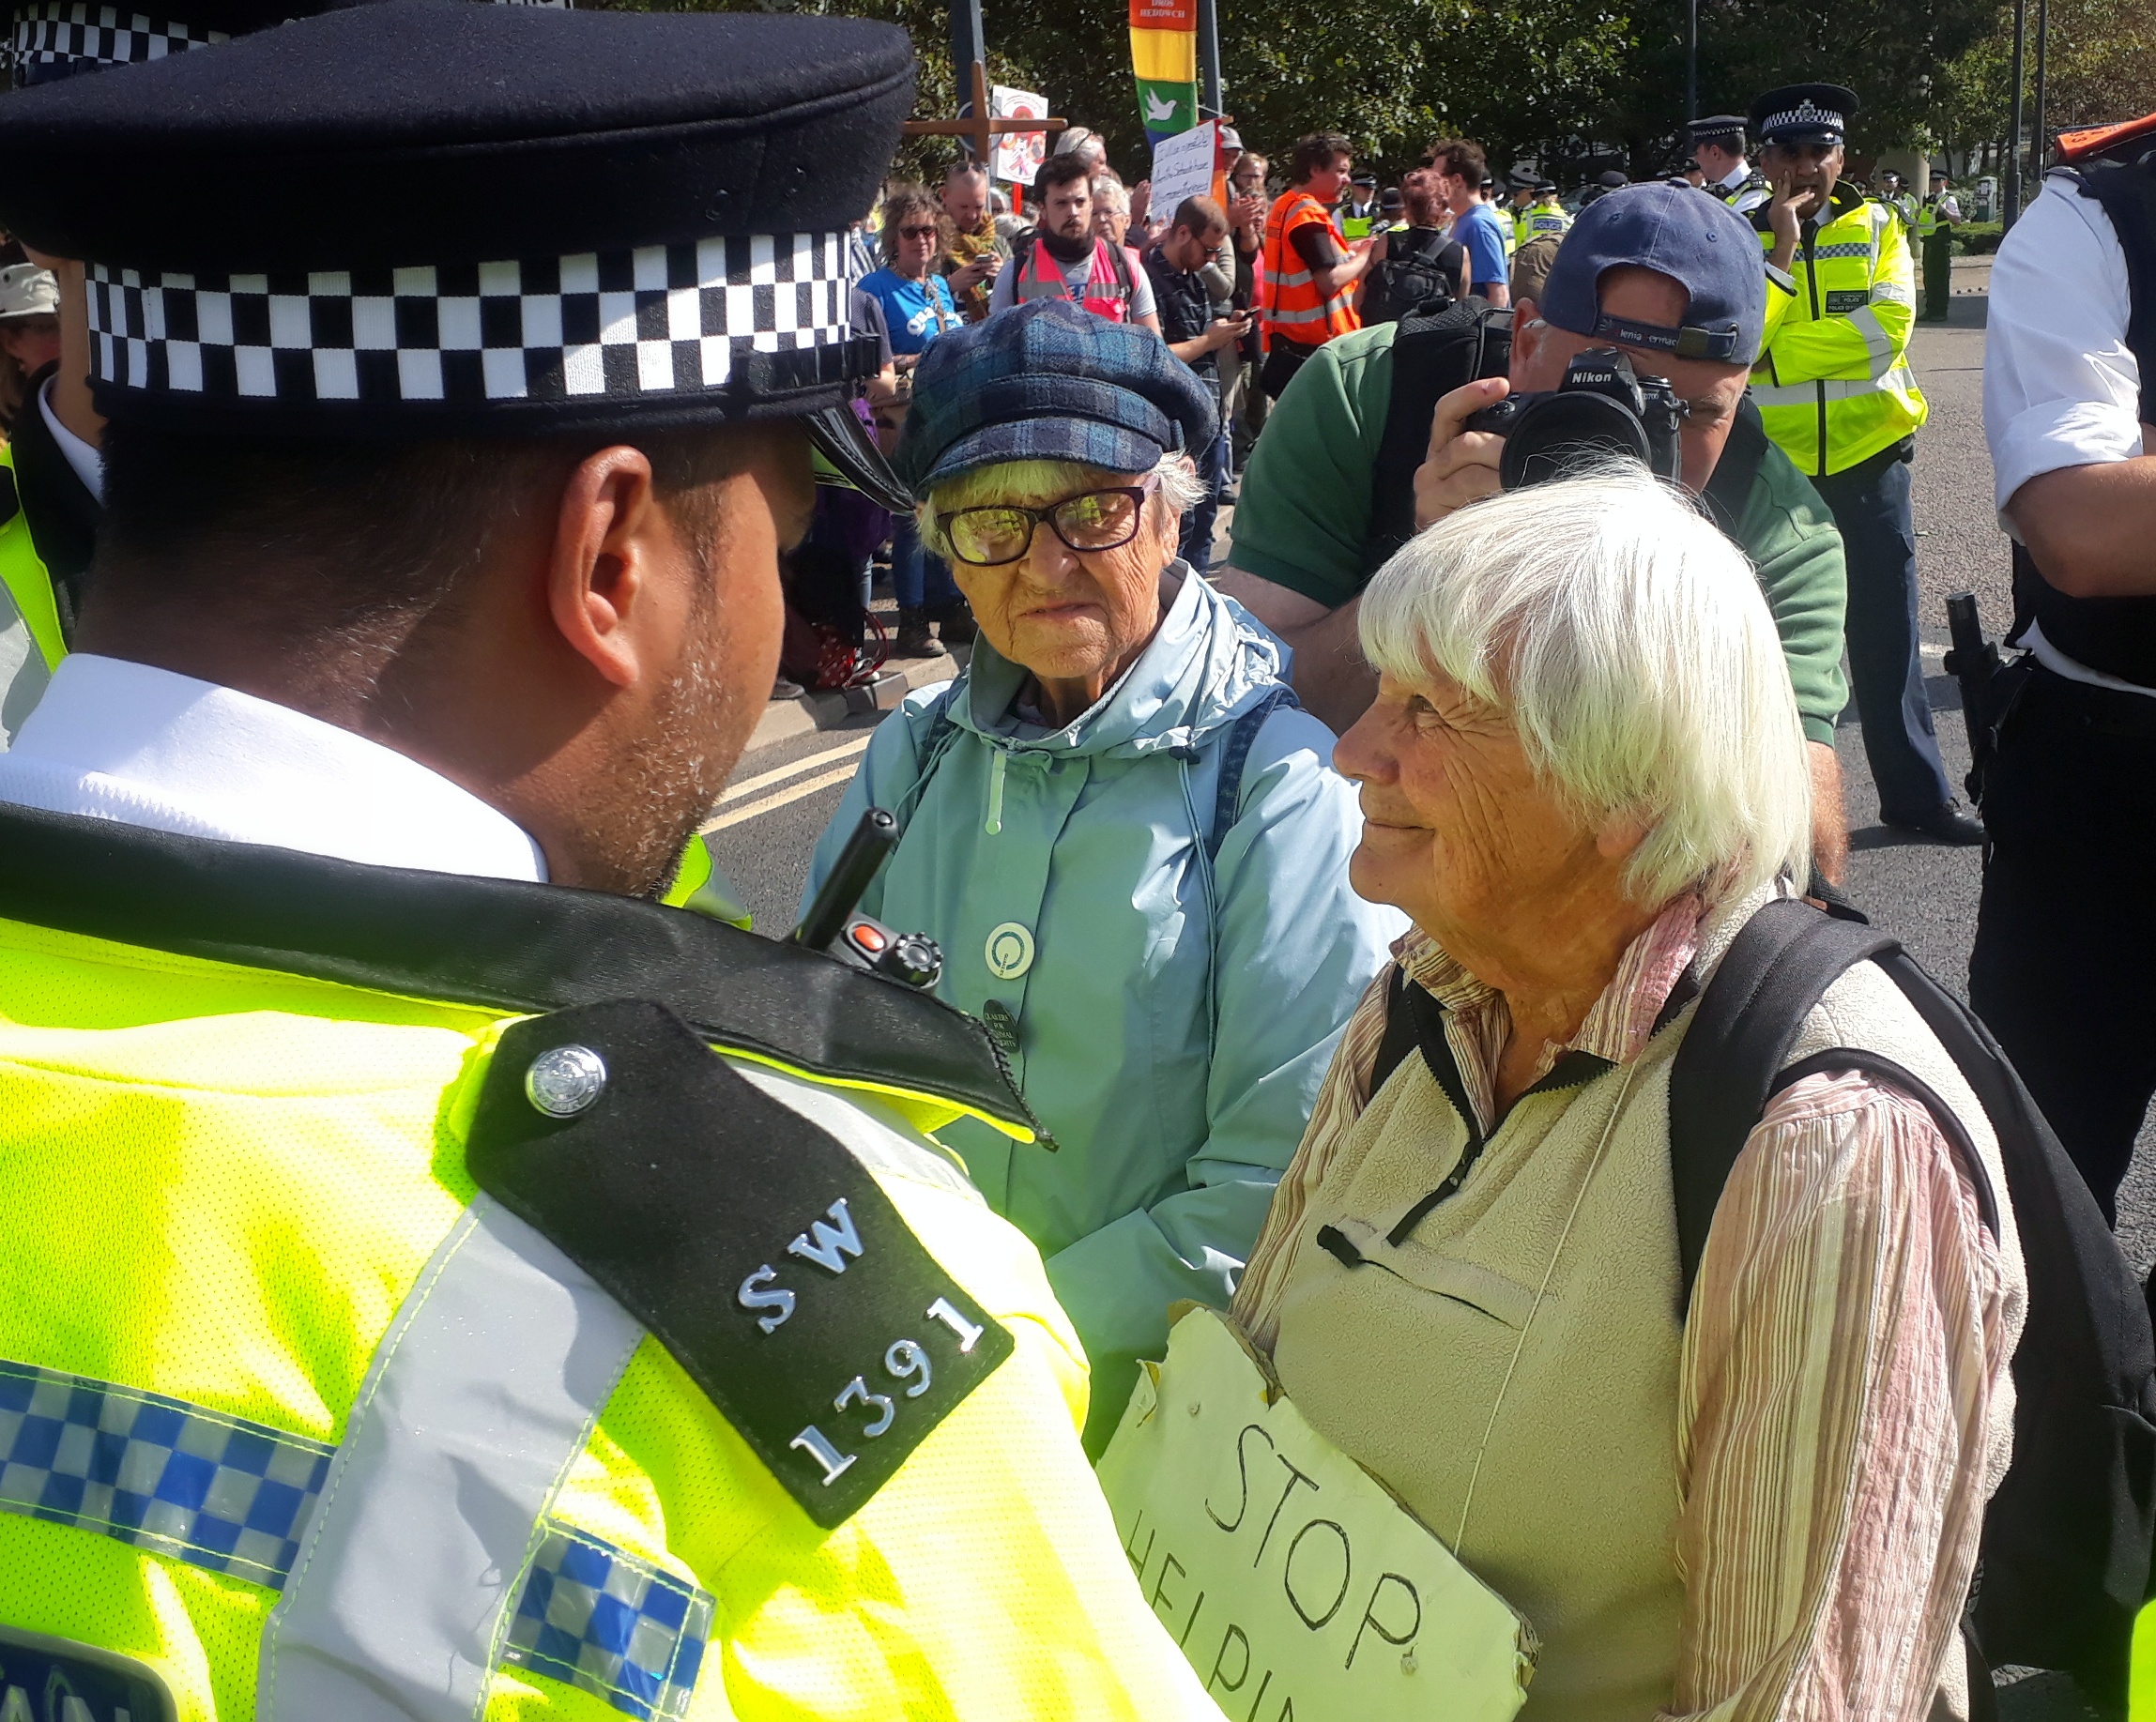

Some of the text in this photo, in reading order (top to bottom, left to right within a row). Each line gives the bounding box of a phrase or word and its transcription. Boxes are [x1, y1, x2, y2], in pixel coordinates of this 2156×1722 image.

[1535, 222, 1560, 231] POLICE
[1572, 372, 1613, 384] Nikon
[789, 1297, 985, 1487] 1391
[1205, 1425, 1422, 1669] STOP
